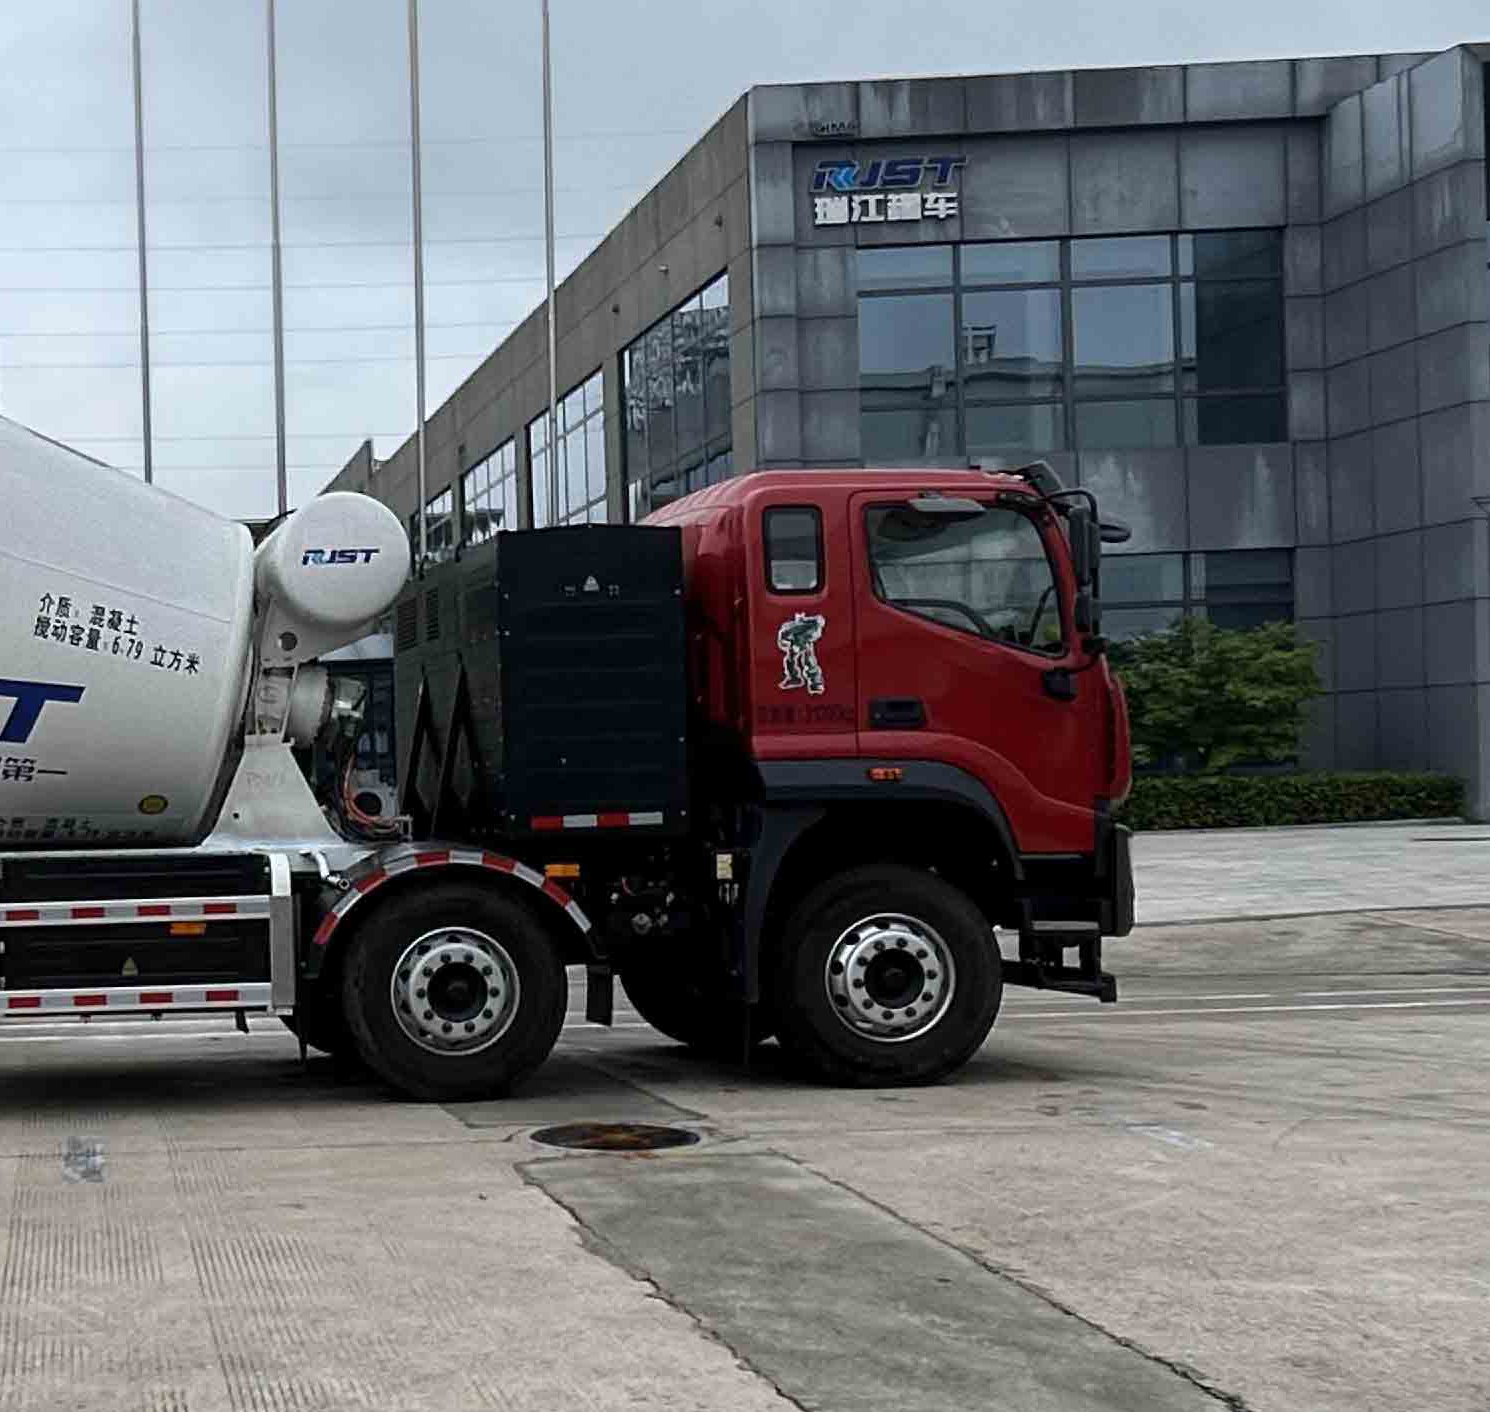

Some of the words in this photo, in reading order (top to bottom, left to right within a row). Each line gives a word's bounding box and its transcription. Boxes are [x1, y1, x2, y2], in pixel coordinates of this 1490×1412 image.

[89, 604, 140, 636] 混凝土
[150, 645, 201, 675] 立方米
